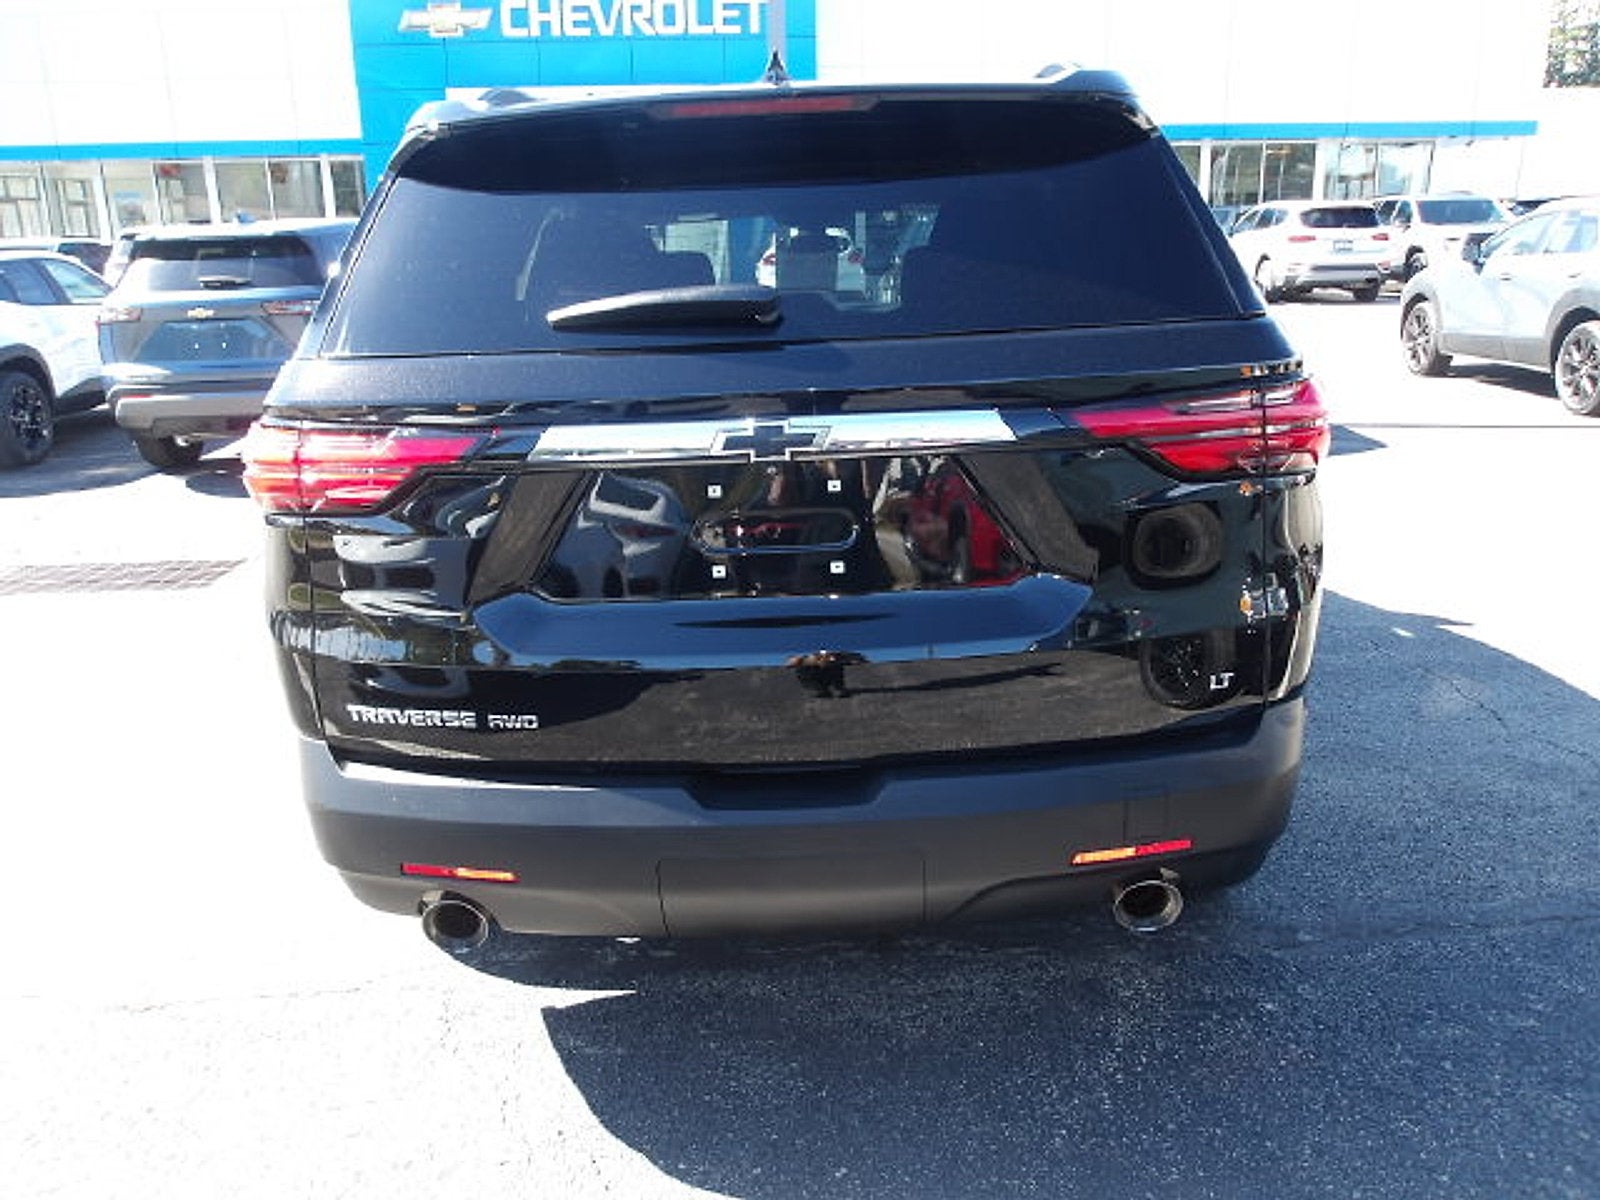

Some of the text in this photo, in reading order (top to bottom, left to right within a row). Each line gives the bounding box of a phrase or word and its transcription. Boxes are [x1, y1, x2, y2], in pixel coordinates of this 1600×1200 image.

[500, 0, 766, 37] CHEVROLET
[1210, 672, 1234, 691] LT
[347, 704, 477, 728] TRAVERSE
